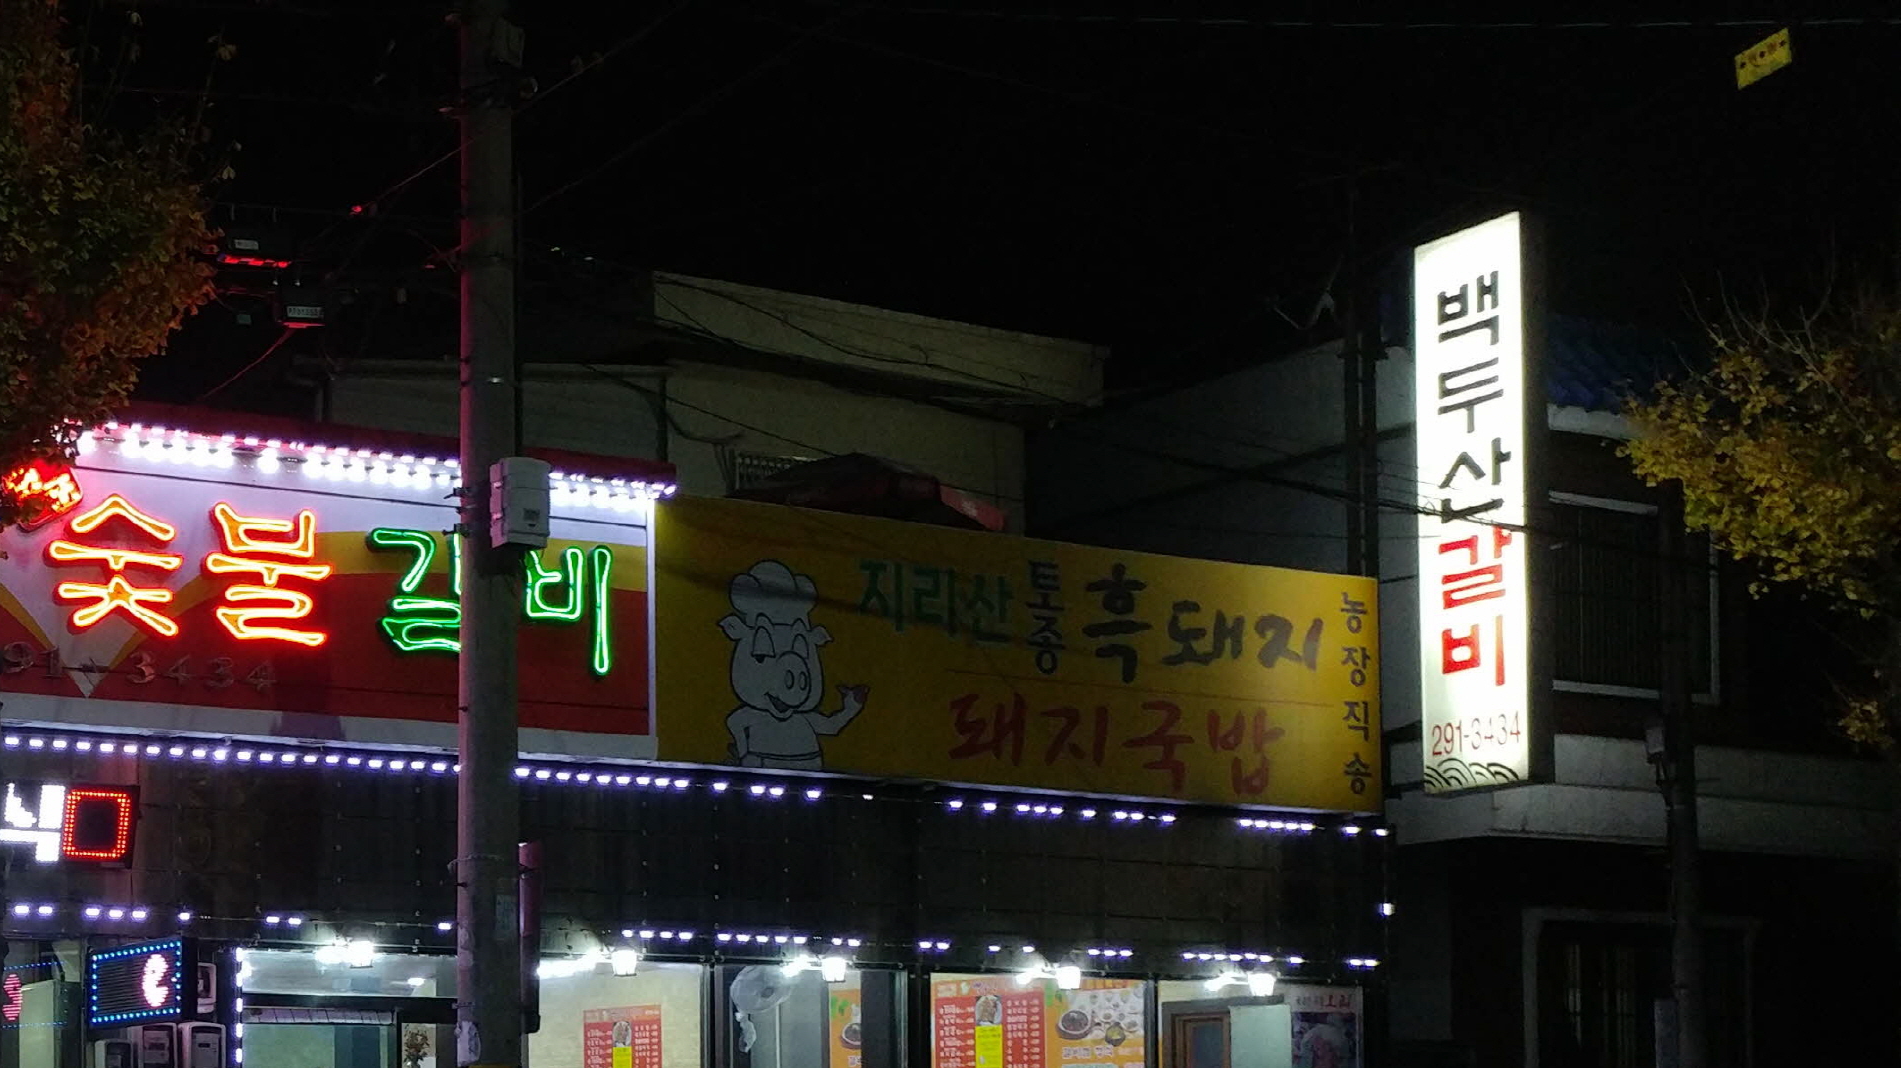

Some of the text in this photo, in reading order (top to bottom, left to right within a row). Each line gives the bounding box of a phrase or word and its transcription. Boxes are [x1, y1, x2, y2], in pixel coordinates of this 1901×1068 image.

[1437, 270, 1511, 688] 백두산 갈비
[46, 494, 333, 647] 숯불
[366, 526, 612, 676] 갈비
[857, 558, 1323, 683] 지리산 토종 흑돼지
[947, 692, 1286, 797] 돼지국밥
[1339, 591, 1373, 796] 농장직송
[1431, 711, 1521, 757] 291-3434
